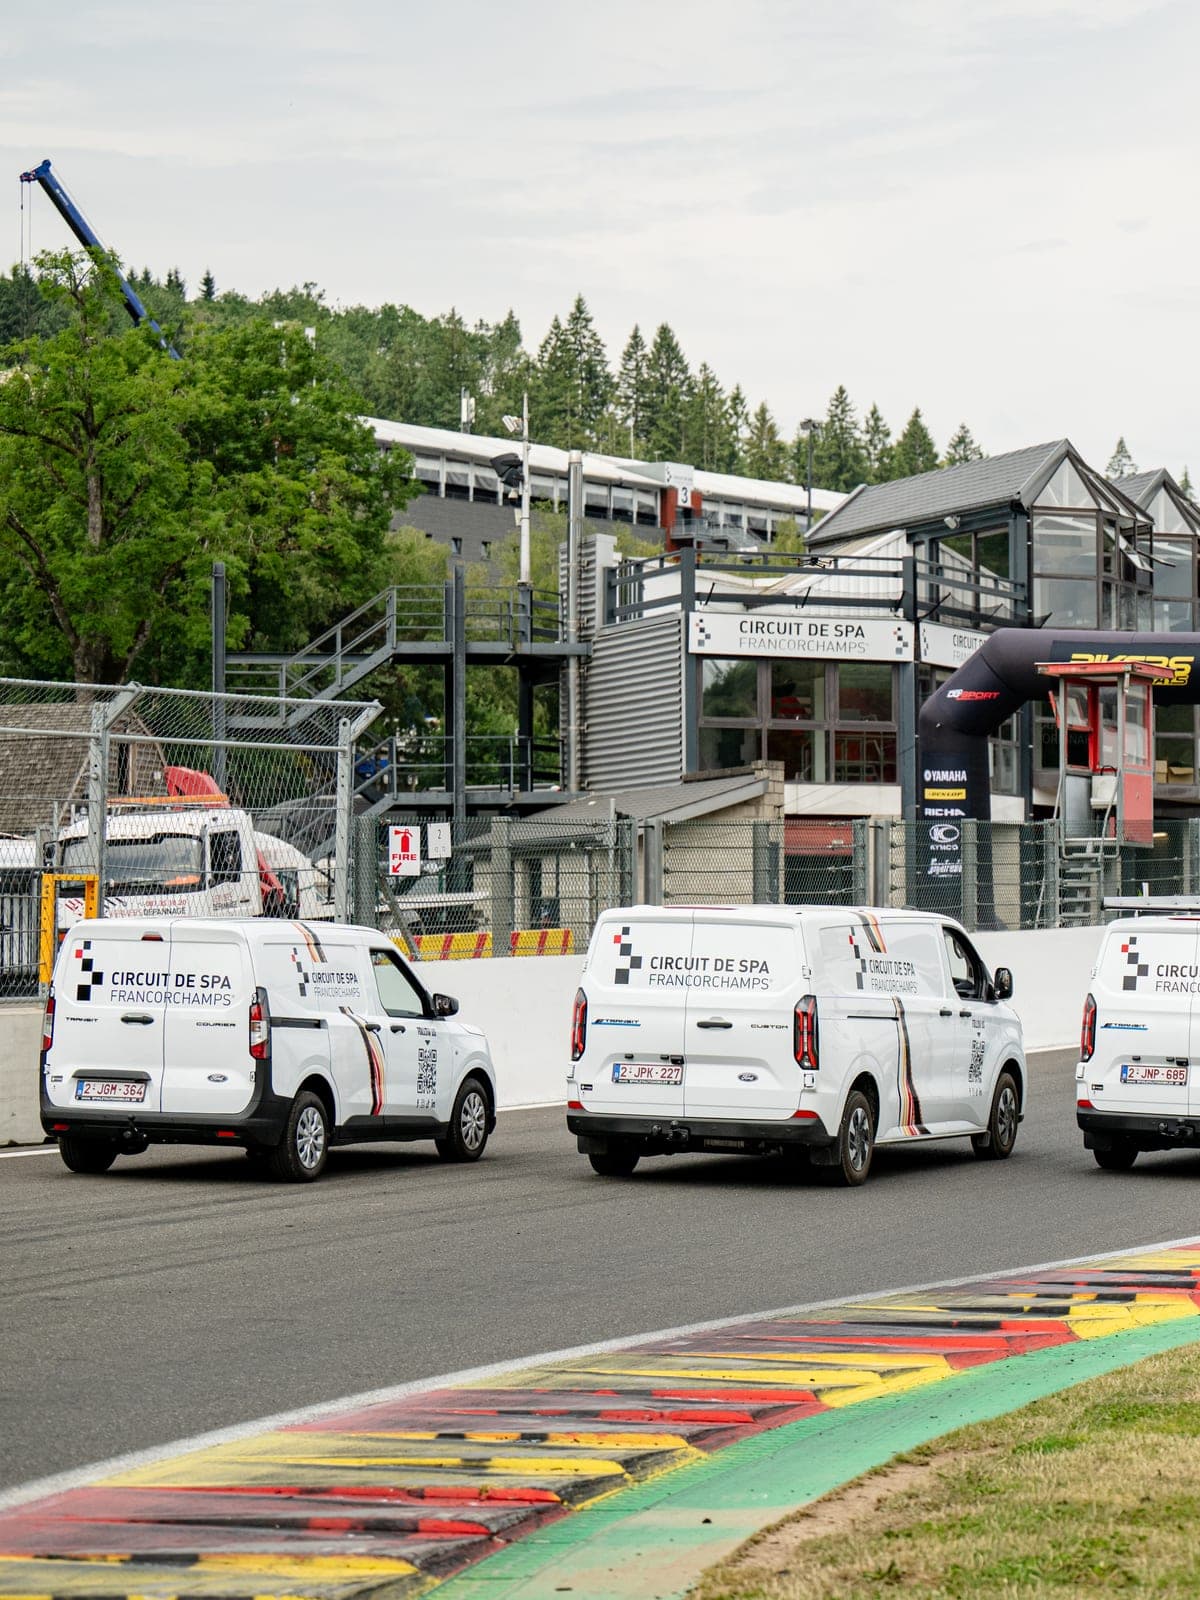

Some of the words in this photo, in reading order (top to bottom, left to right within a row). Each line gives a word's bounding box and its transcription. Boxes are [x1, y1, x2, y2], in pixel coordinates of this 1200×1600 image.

[681, 486, 689, 504] 3
[739, 620, 804, 636] CIRCUIT
[808, 622, 830, 637] DE
[834, 623, 866, 639] SPA
[739, 637, 866, 654] FRANCORCHAMPS
[953, 634, 978, 650] CIRCUIT
[931, 770, 967, 782] YAMAHA
[924, 808, 966, 817] RICHA
[391, 853, 417, 861] FIRE
[650, 956, 711, 972] CIRCUIT
[714, 958, 735, 973] DE
[739, 959, 770, 974] SPA
[869, 959, 893, 975] CIRCUIT
[894, 961, 903, 975] DE
[904, 961, 916, 976] SPA
[111, 971, 170, 987] CIRCUIT
[175, 974, 196, 988] DE
[200, 975, 232, 989] SPA
[312, 972, 335, 984] CIRCUIT
[336, 972, 345, 984] DE
[346, 973, 358, 984] SPA
[648, 973, 770, 990] FRANCORCHAMPS
[870, 979, 918, 994] FRANCORCHAMPS
[110, 989, 232, 1006] FRANCORCHAMPS
[313, 987, 361, 997] FRANCORCHAMPS
